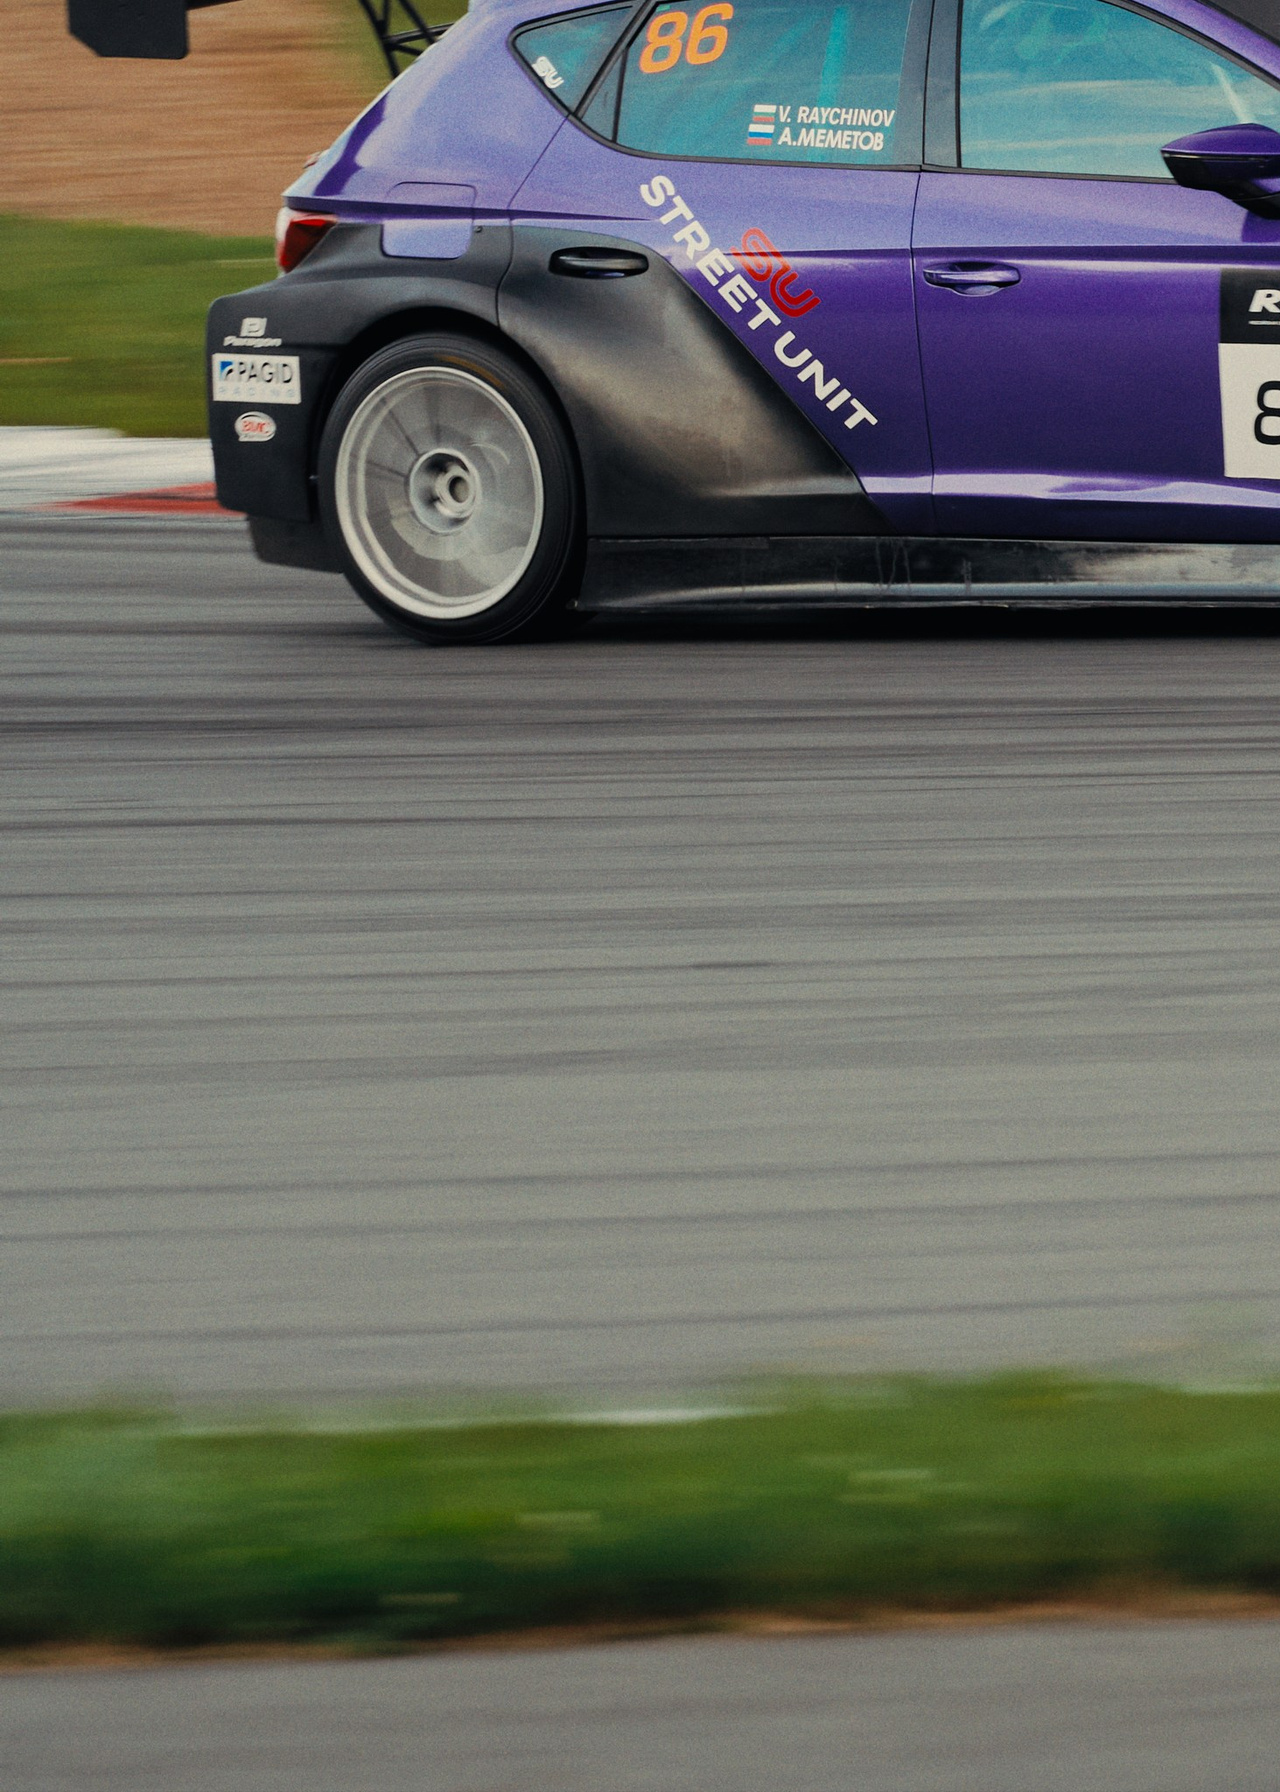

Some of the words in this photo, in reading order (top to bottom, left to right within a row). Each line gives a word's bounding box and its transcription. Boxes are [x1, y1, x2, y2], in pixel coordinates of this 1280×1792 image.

[639, 2, 734, 74] 86
[779, 105, 791, 123] V.
[797, 106, 895, 127] RAYCHINOV
[777, 127, 884, 151] A.MEMETOB
[640, 175, 782, 330] STREET
[774, 330, 879, 430] UNIT
[238, 360, 293, 384] PAGID
